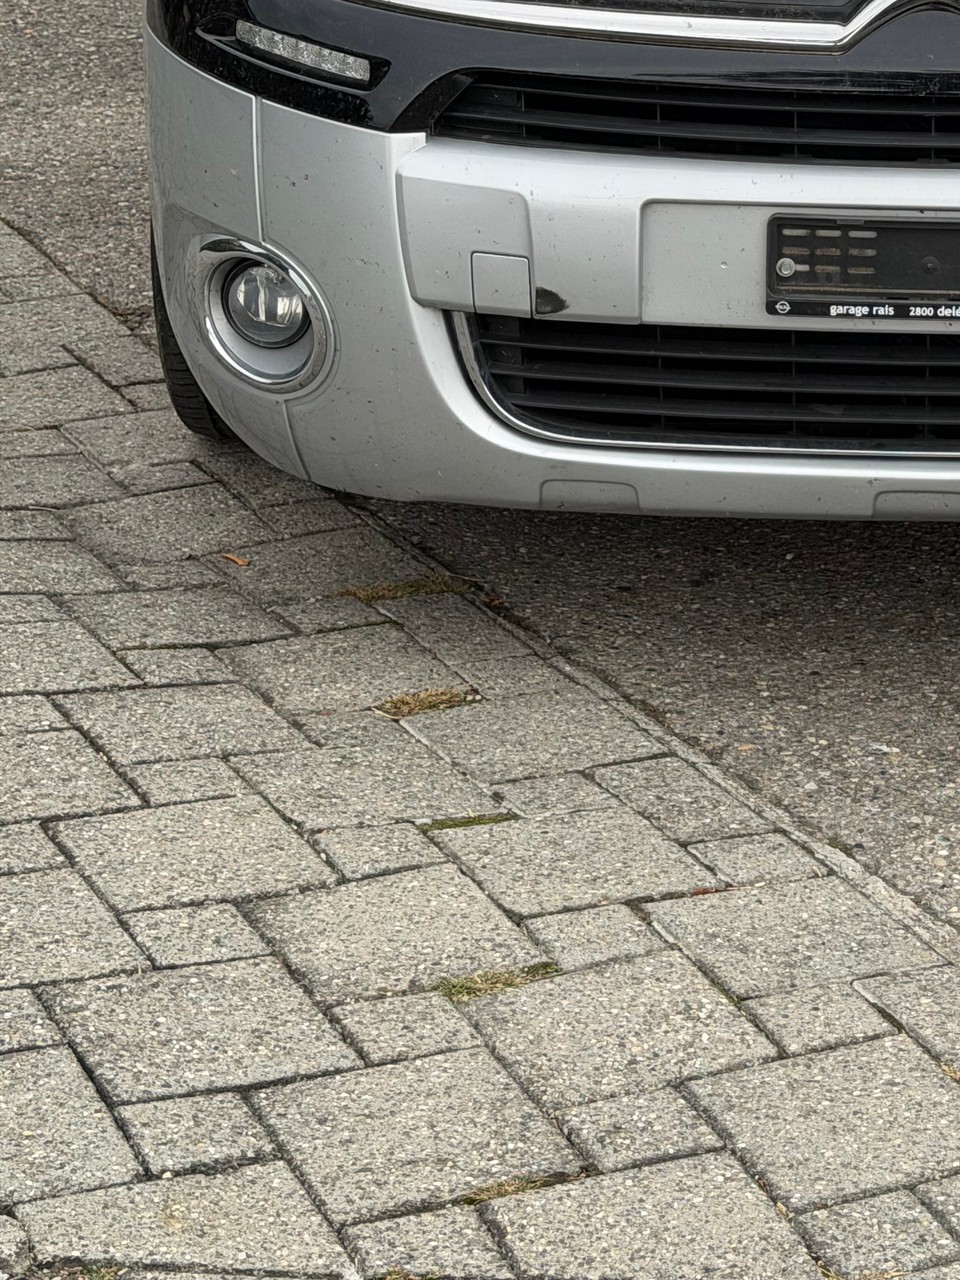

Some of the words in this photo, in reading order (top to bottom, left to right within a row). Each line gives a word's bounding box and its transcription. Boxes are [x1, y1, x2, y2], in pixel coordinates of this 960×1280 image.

[829, 304, 870, 317] garage
[872, 304, 895, 316] rais
[909, 306, 934, 317] 2800
